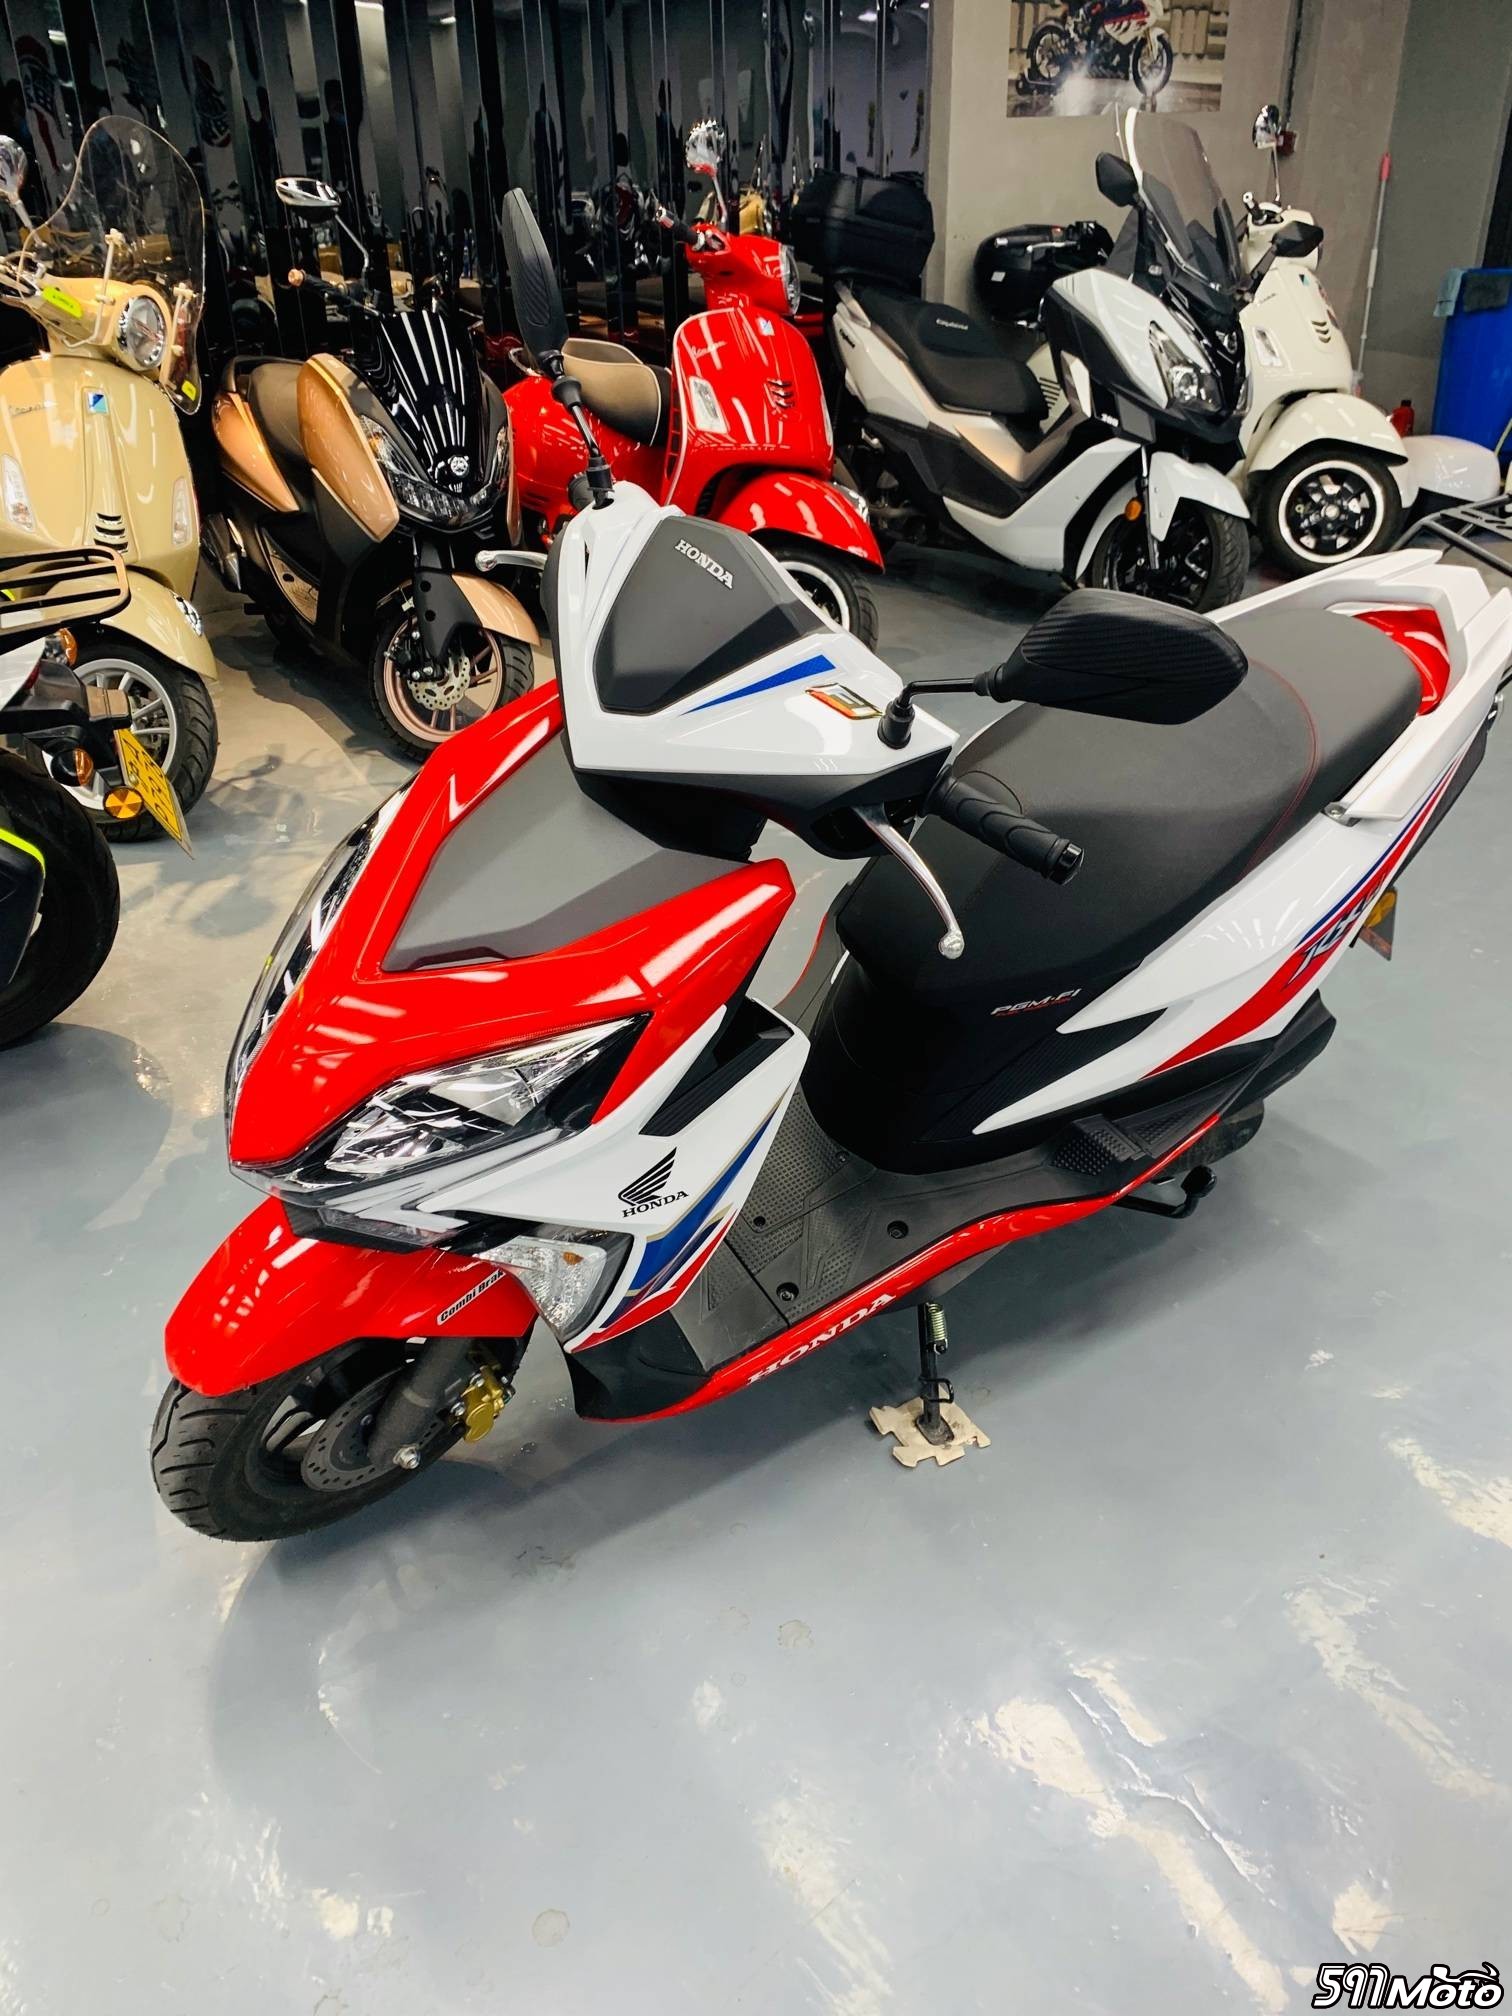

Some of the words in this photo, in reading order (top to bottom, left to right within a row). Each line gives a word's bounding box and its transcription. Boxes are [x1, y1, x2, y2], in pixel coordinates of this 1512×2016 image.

[674, 538, 734, 590] HONDA
[622, 1190, 689, 1218] HONDA
[440, 1288, 477, 1322] Combi
[478, 1269, 505, 1294] Brak
[746, 1293, 897, 1386] HONDA
